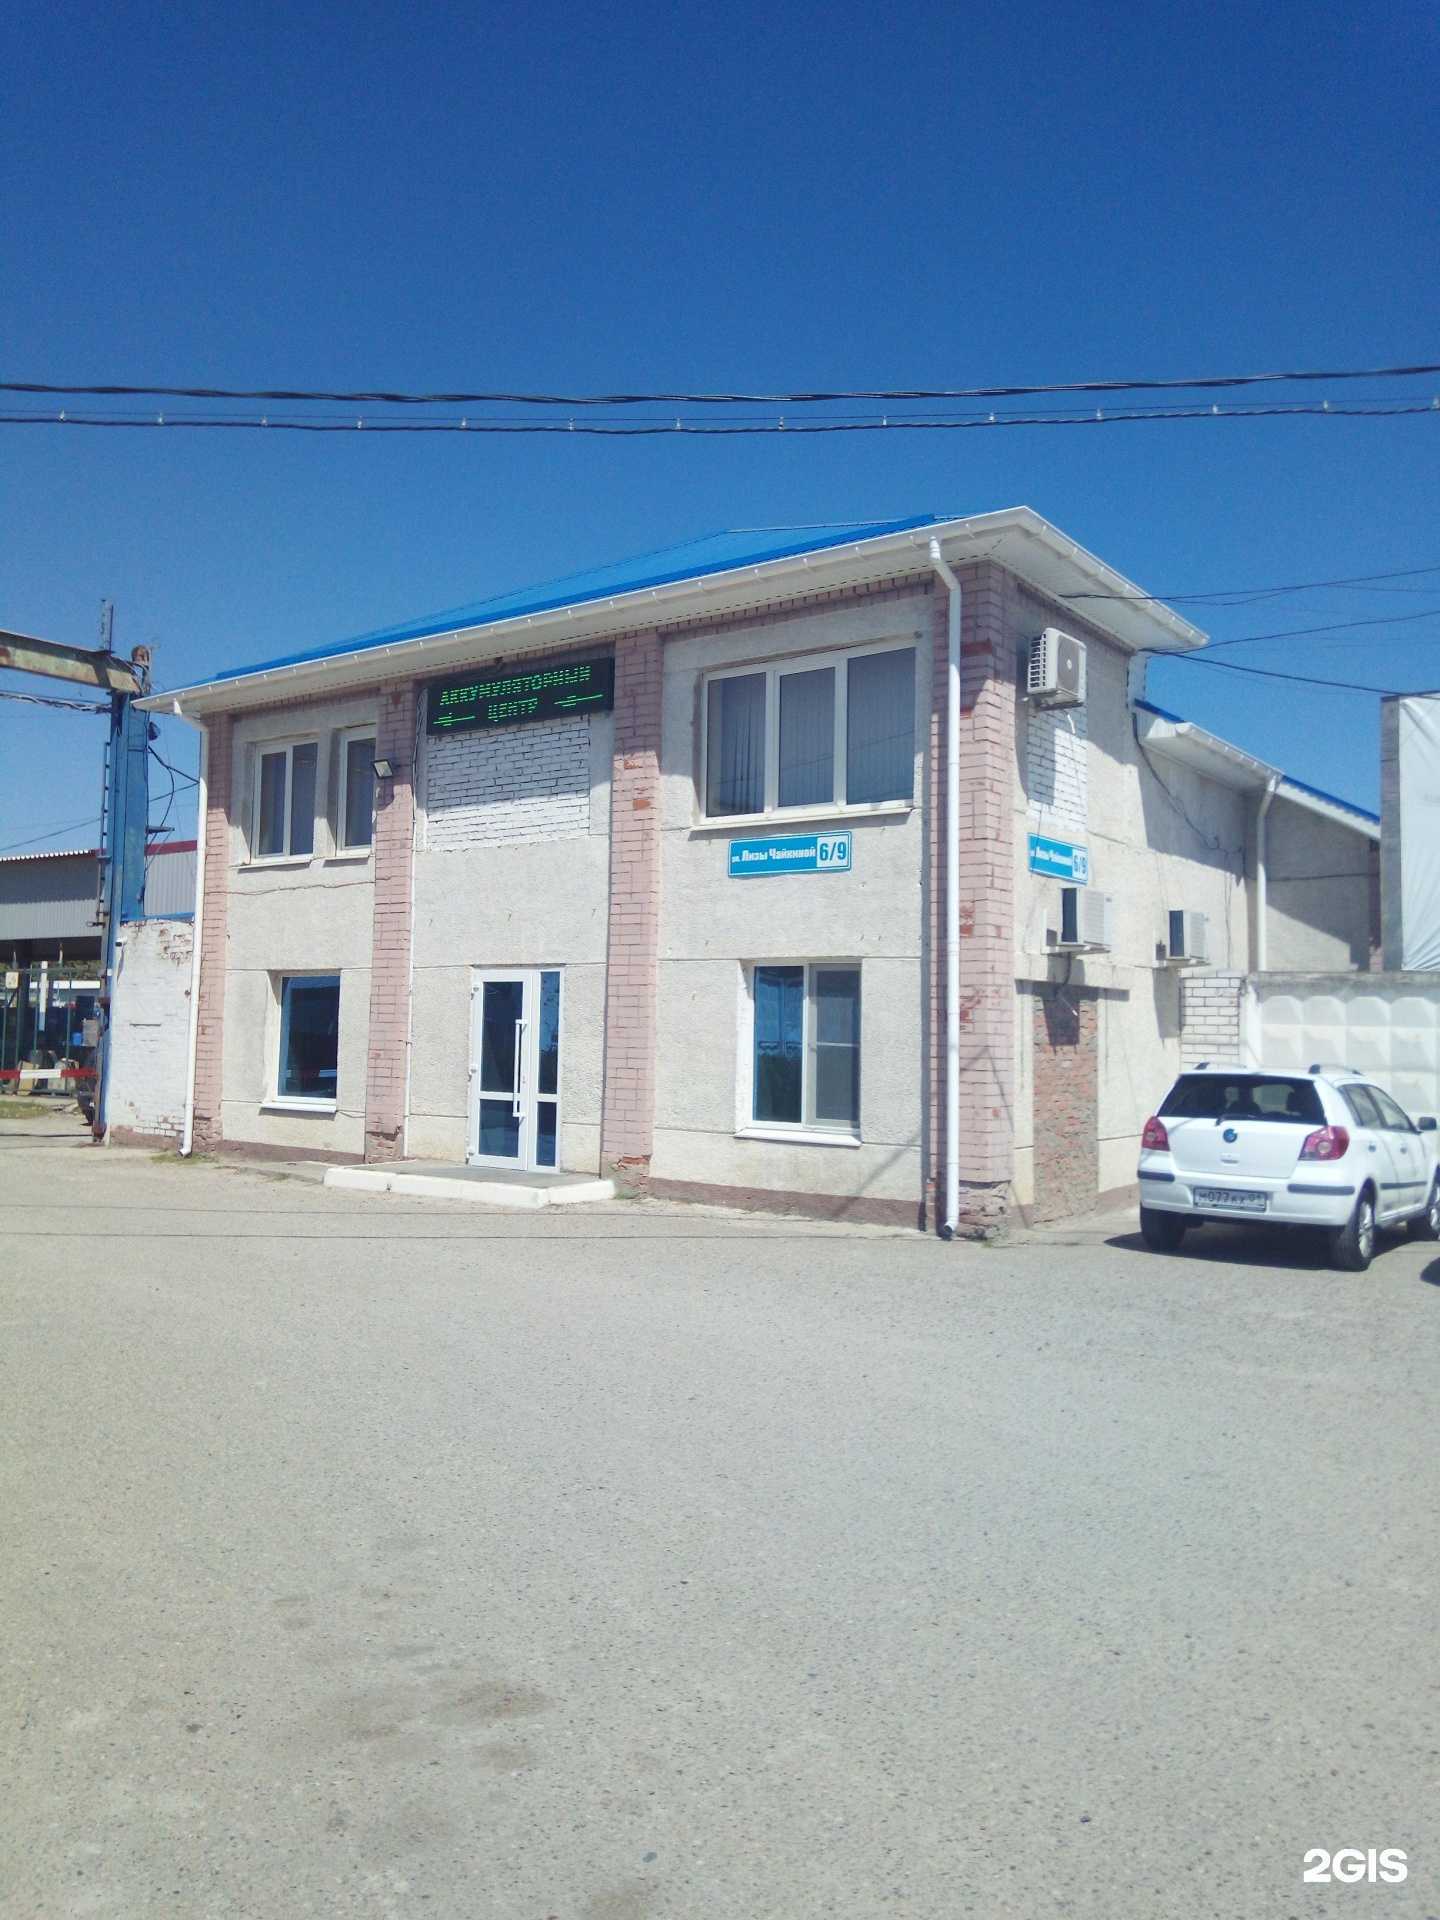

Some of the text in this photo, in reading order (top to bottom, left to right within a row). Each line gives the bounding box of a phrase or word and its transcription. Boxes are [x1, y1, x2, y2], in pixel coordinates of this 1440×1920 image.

[488, 697, 538, 722] ЦЕНТР
[741, 849, 768, 862] Лизы
[768, 846, 816, 860] Чайкиной
[820, 842, 847, 861] 6/9
